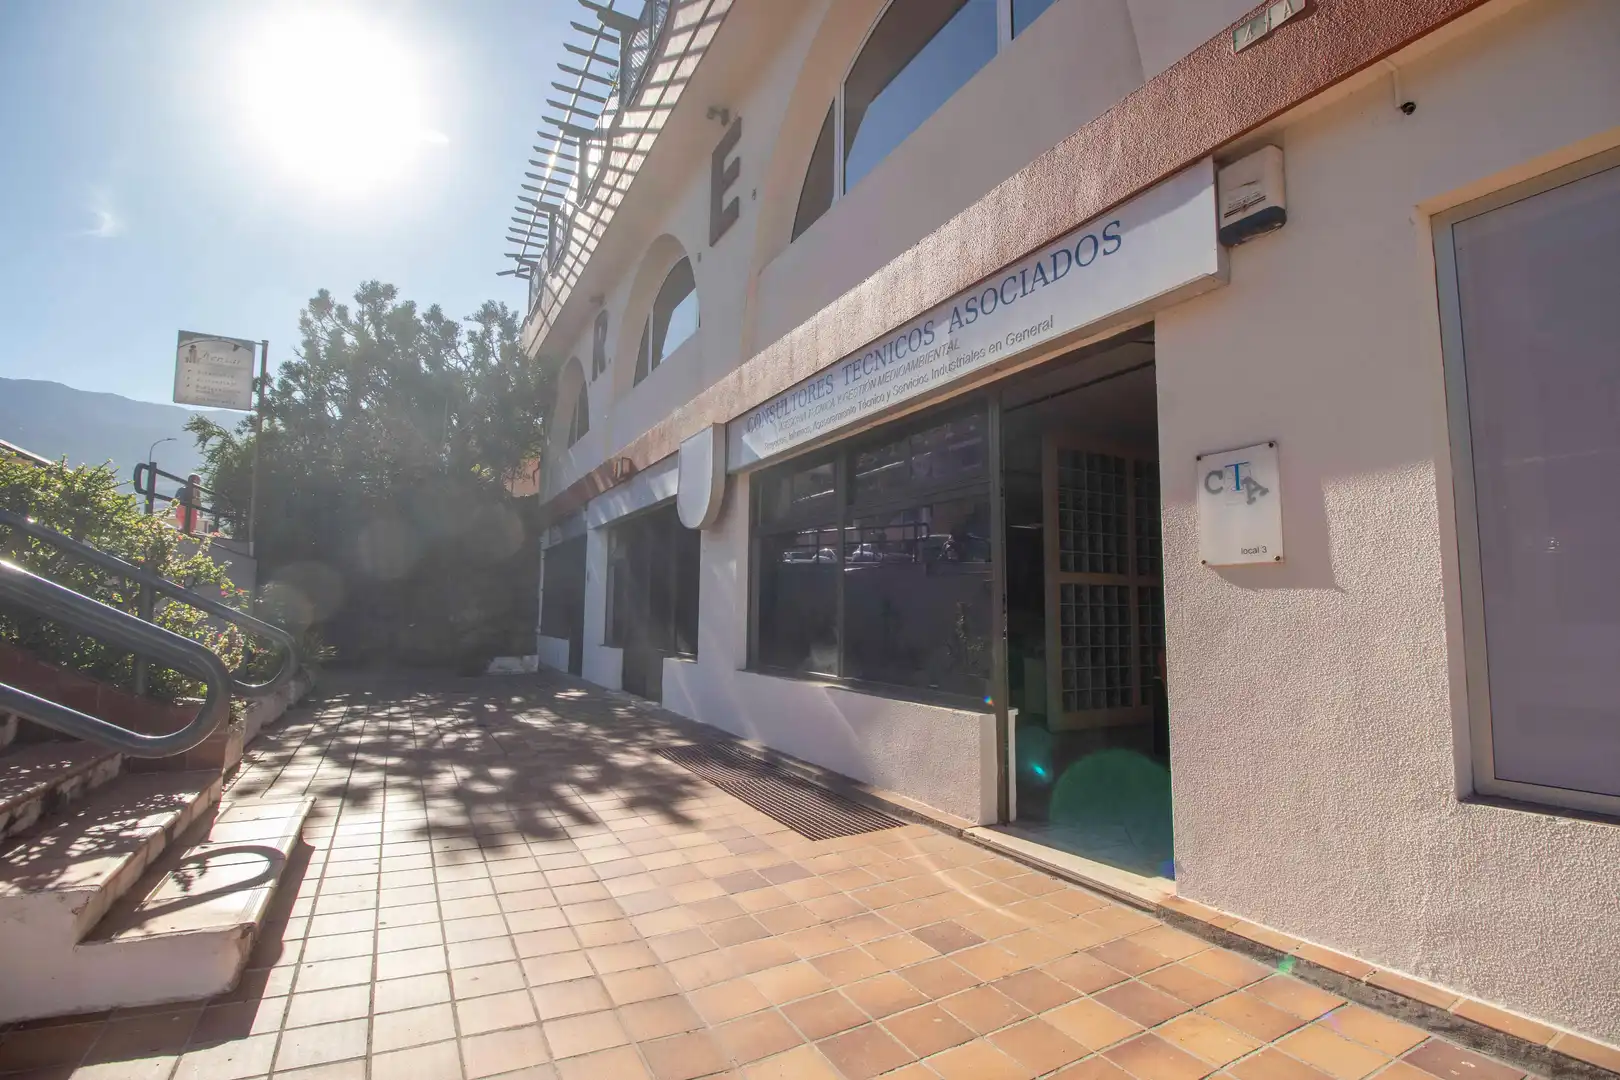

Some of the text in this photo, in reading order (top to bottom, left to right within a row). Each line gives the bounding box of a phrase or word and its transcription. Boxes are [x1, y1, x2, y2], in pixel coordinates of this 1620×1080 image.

[709, 116, 742, 247] E
[746, 220, 1122, 432] CONSULTORES TECNICOS ASOCIADOS
[892, 373, 929, 396] Servicios
[931, 346, 986, 380] Industriales
[988, 339, 1003, 354] en
[1005, 315, 1054, 346] General
[877, 338, 960, 385] MEDIOAMBIENTAL
[1204, 461, 1269, 505] CTA
[1241, 546, 1267, 555] local 3
